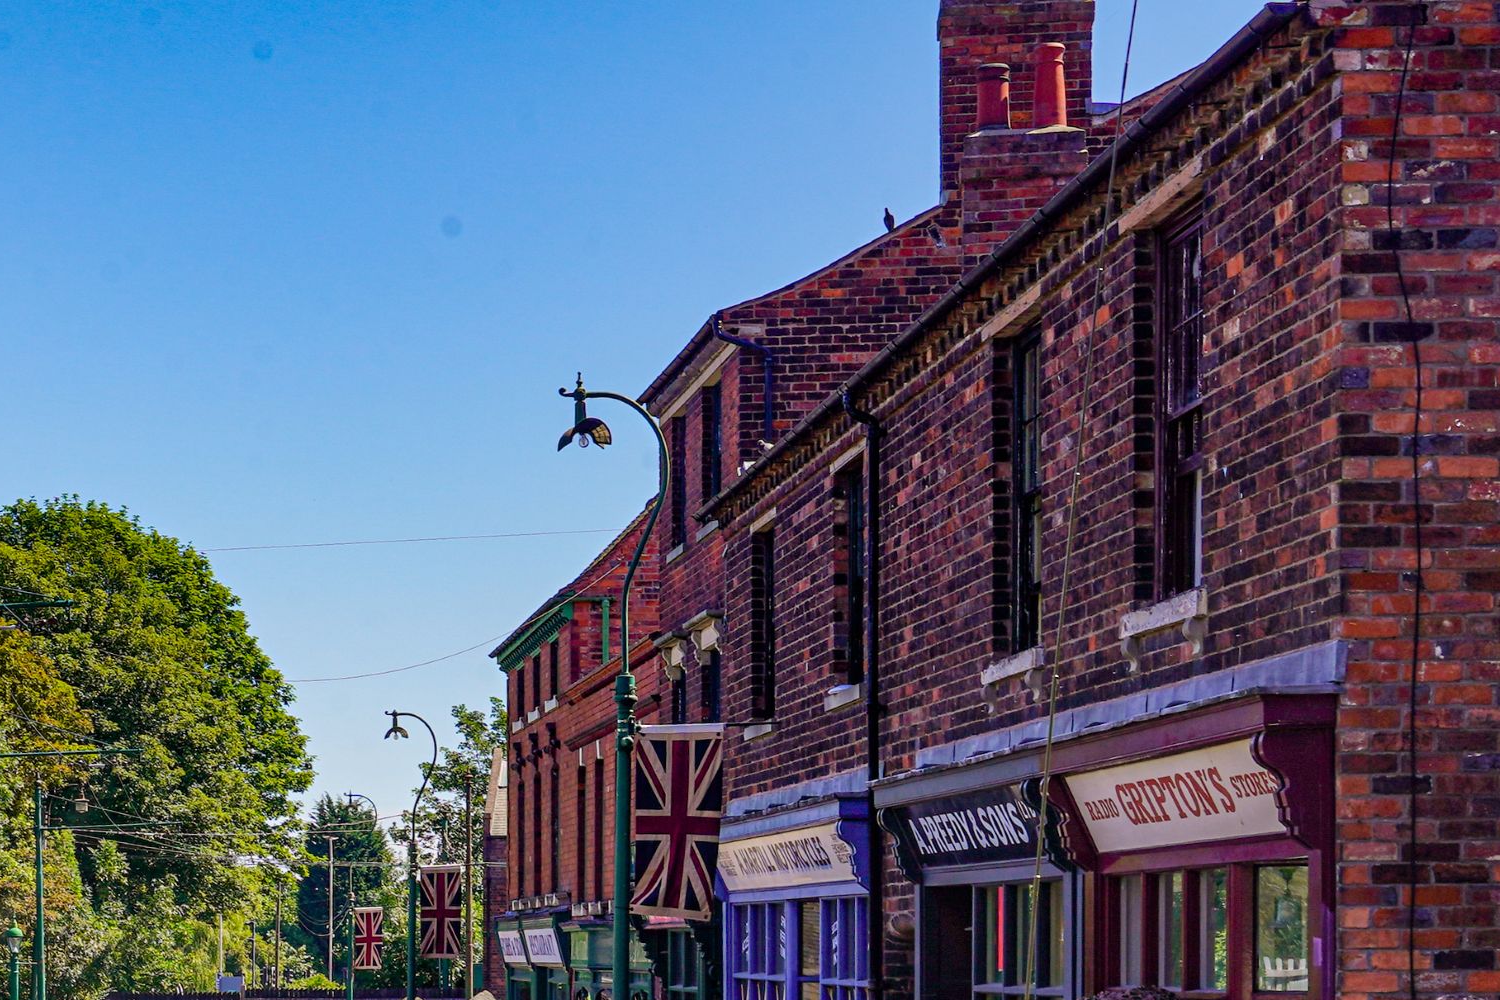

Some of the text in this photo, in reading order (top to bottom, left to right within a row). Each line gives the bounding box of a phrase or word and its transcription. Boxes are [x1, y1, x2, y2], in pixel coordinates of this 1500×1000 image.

[1084, 766, 1279, 826] RADIO GRIPTON'S STORES
[977, 802, 1030, 849] SONS
[767, 835, 832, 873] MOTORCYCLES
